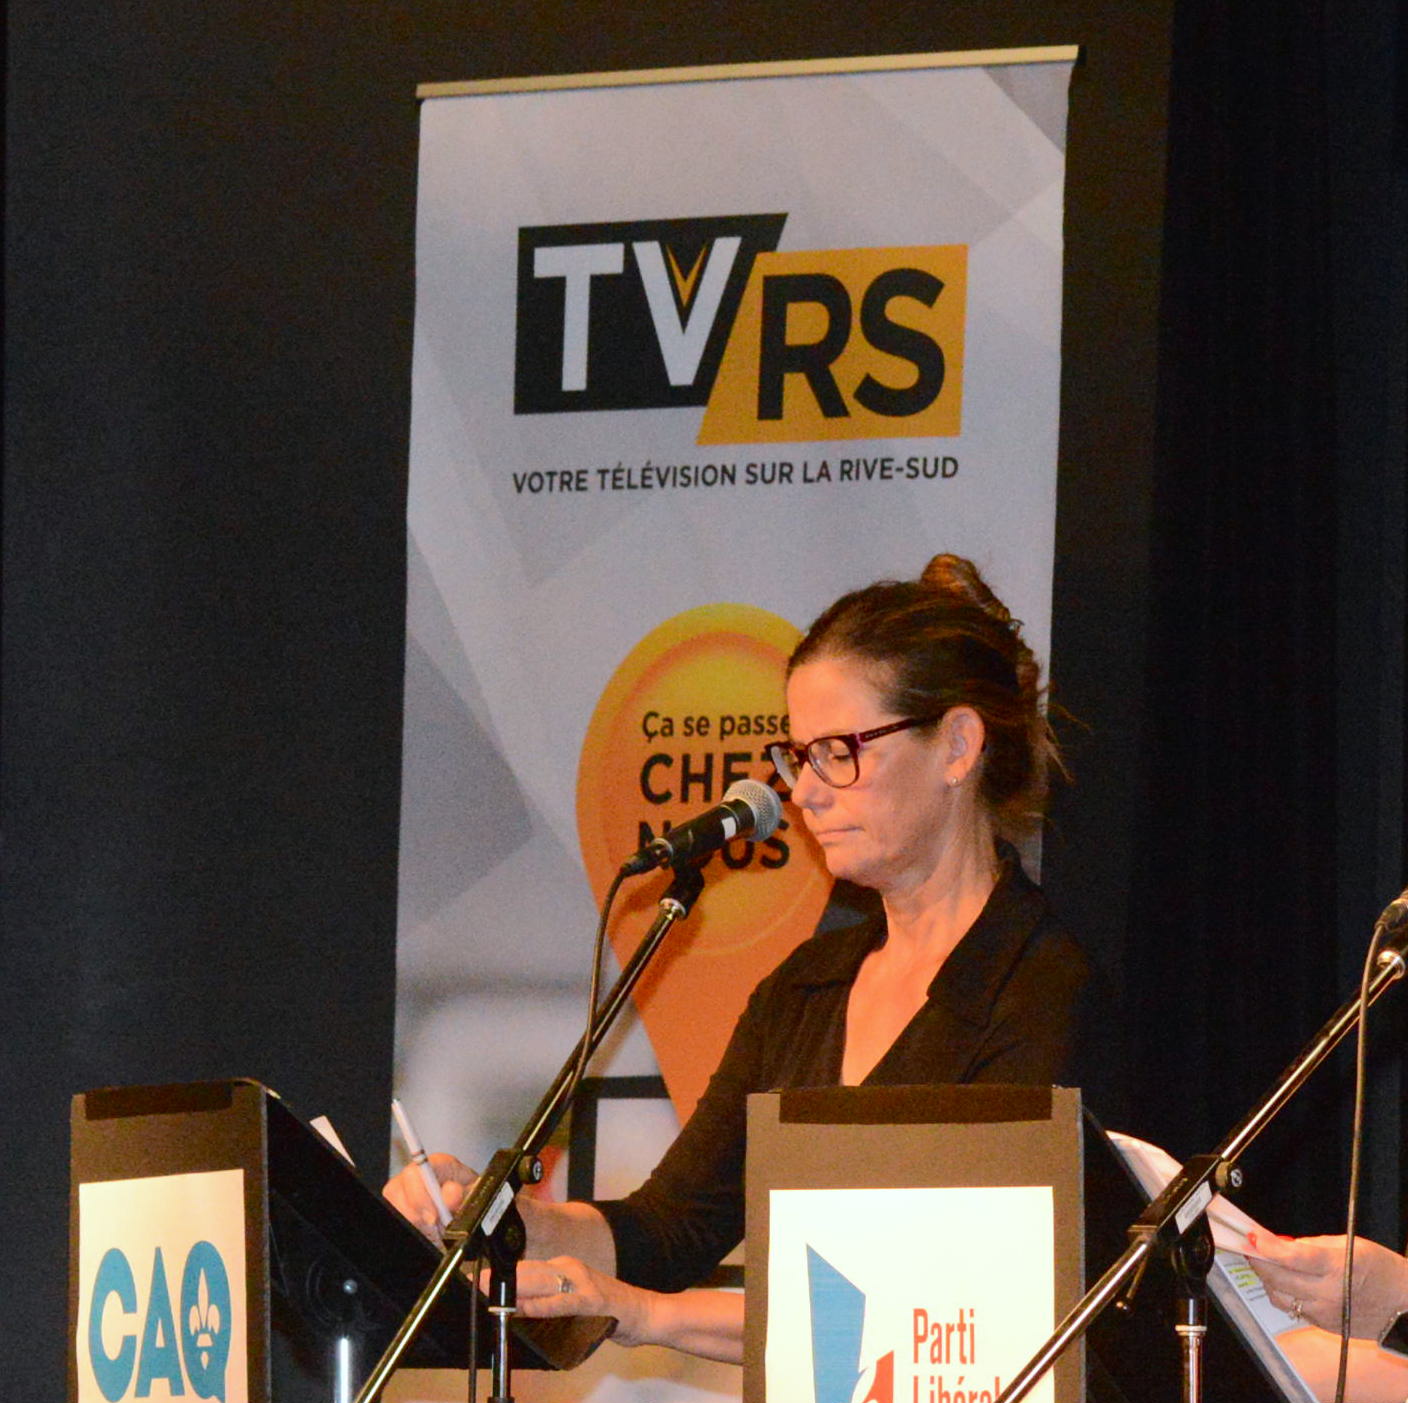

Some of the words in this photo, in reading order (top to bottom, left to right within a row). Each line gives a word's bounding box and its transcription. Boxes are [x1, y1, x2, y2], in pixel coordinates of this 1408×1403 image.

[533, 236, 945, 420] TVRS
[513, 469, 588, 493] VOTRE
[596, 460, 736, 490] TÉLÉVISION
[746, 461, 793, 485] SUR
[803, 460, 831, 483] LA
[840, 456, 958, 482] RIVE-SUD
[642, 711, 674, 742] Ça
[683, 714, 710, 737] se
[719, 713, 790, 741] passe
[912, 1308, 975, 1364] Parti
